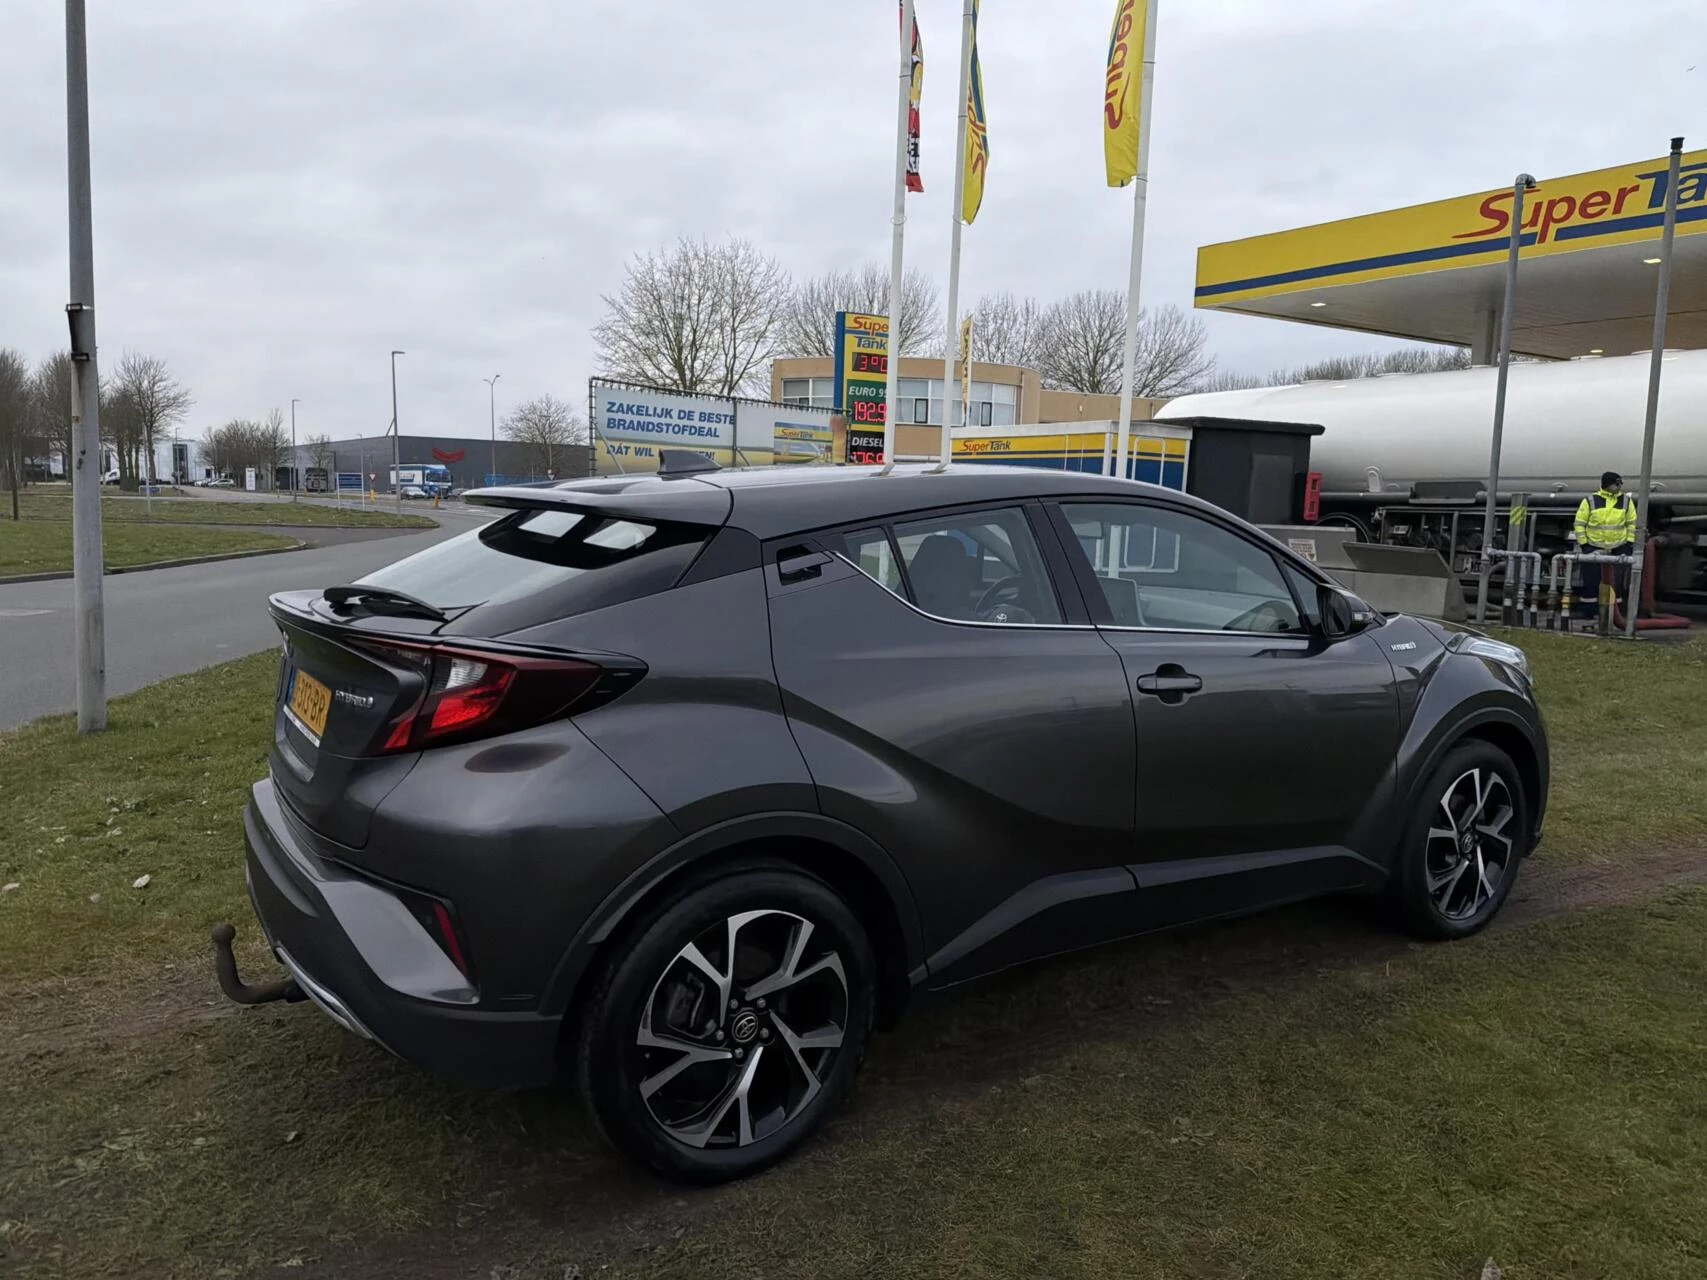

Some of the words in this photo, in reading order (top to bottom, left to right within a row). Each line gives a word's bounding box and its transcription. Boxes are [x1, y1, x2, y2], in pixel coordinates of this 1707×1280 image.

[854, 335, 888, 350] Tank
[848, 385, 876, 397] EURO
[606, 401, 673, 420] ZAKELIJK
[677, 409, 695, 421] DE
[698, 411, 735, 425] BESTE
[606, 417, 720, 438] BRANDSTOFDEAL
[852, 437, 884, 448] DIESEL
[634, 446, 654, 457] WIL
